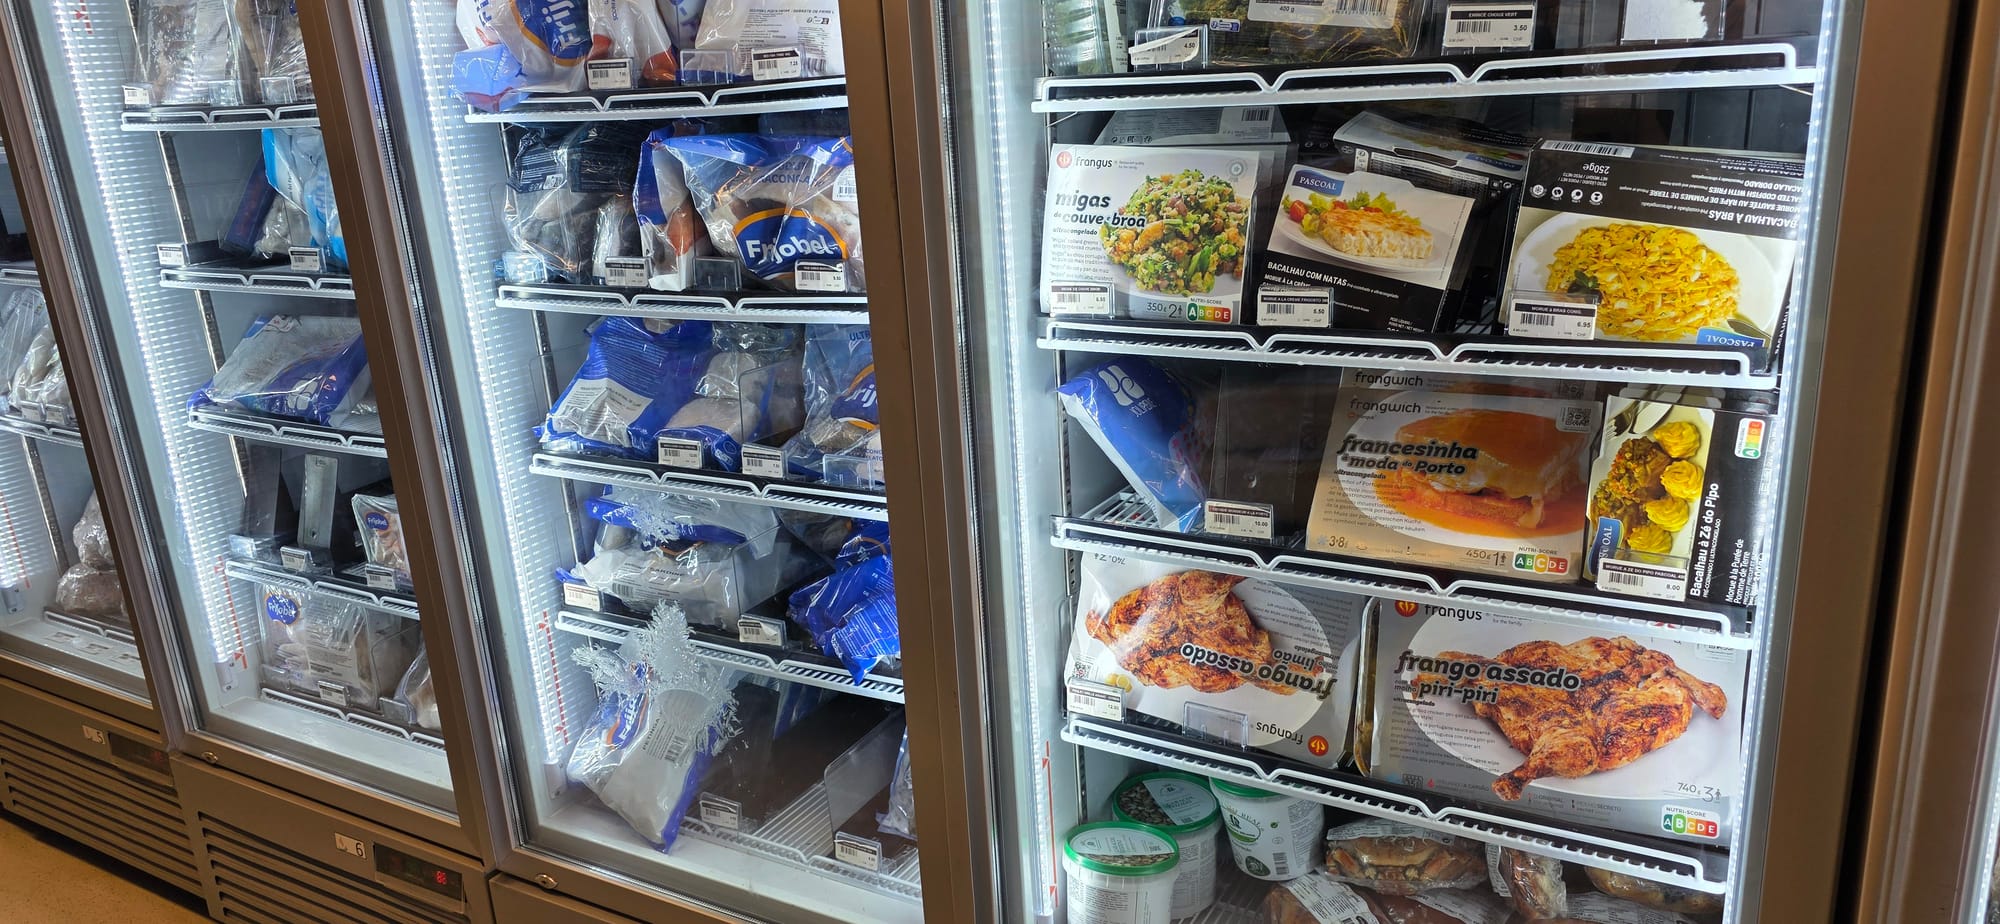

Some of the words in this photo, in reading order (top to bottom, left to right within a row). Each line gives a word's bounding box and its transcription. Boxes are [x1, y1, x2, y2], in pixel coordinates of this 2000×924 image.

[1076, 157, 1112, 169] frangus
[1300, 176, 1337, 191] PASCOAL
[1708, 185, 1727, 194] FRIES
[1743, 179, 1772, 189] DORADO
[1648, 188, 1669, 198] TERRE
[1669, 191, 1679, 199] DE
[1679, 192, 1709, 202] POMMES
[1727, 188, 1746, 196] WITH
[1746, 189, 1776, 200] CODFISH
[1056, 190, 1111, 211] migas
[1737, 199, 1749, 207] AU
[1749, 200, 1775, 211] SAUTÉE
[1062, 214, 1104, 224] couve
[1112, 212, 1146, 227] broa
[1707, 209, 1734, 222] BRÁS
[1735, 212, 1743, 223] À
[1743, 213, 1797, 228] BACALHAU
[1053, 227, 1097, 235] ultracongelado
[1264, 274, 1281, 282] MORUE
[1282, 277, 1287, 285] À
[1268, 261, 1305, 277] BACALHAU
[1305, 270, 1323, 281] COM
[1323, 274, 1348, 287] NATAS
[1169, 304, 1177, 318] 2
[1705, 334, 1755, 347] PASCOAL
[1355, 372, 1423, 387] frangwich
[1350, 398, 1421, 414] frangwich
[1337, 433, 1477, 459] francesinha
[1349, 456, 1398, 470] moda
[1415, 460, 1466, 474] Porto
[1334, 469, 1386, 480] ultracongelado
[1704, 481, 1721, 508] Pipo
[1701, 508, 1714, 523] do
[1699, 524, 1711, 539] Zé
[1709, 518, 1721, 559] ULTRACONGELADO
[1518, 546, 1558, 555] NUTRI-SCORE
[1698, 539, 1709, 547] à
[1734, 538, 1744, 548] de
[1493, 552, 1499, 566] 1
[1731, 548, 1742, 568] Purée
[1740, 551, 1750, 568] Terre
[1689, 548, 1707, 596] Bacalhau
[1738, 567, 1747, 577] de
[1724, 579, 1736, 602] Morue
[1734, 577, 1745, 604] Pomme
[1425, 605, 1483, 621] frangus
[1181, 645, 1252, 674] assado
[1273, 650, 1315, 673] limão
[1395, 650, 1481, 680] frango
[1486, 667, 1580, 690] assado
[1257, 665, 1337, 699] frango
[1394, 684, 1417, 693] molho
[1419, 680, 1499, 704] piri-piri
[1256, 721, 1303, 745] frangus
[1702, 786, 1714, 802] 3
[1666, 807, 1706, 817] NUTRI-SCORE
[355, 843, 364, 857] 6
